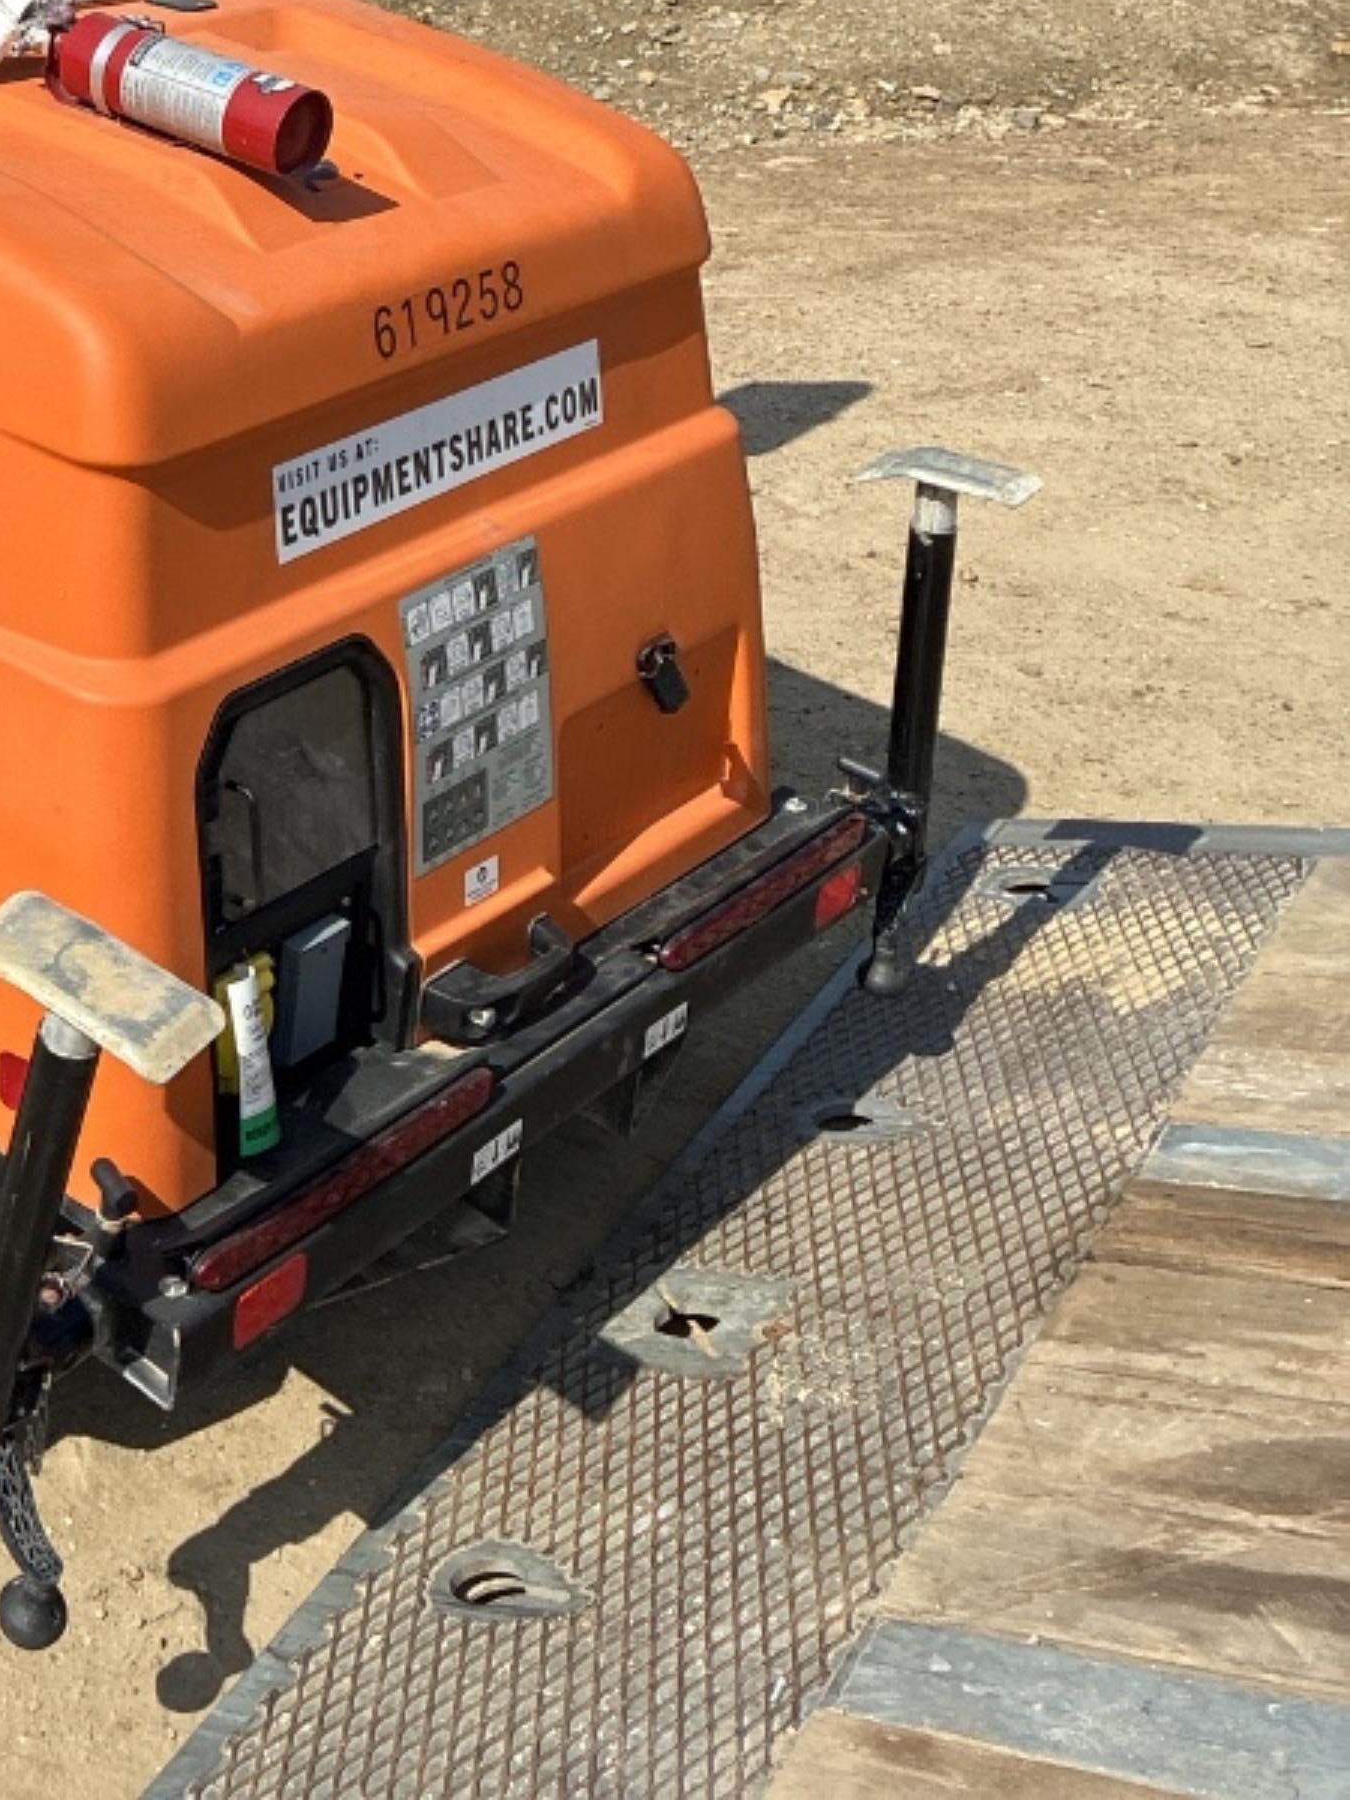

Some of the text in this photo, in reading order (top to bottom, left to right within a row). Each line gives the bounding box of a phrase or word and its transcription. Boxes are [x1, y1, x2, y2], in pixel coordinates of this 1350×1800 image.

[373, 260, 524, 359] 619258
[276, 438, 380, 493] VISIT US AT:
[280, 377, 600, 547] EQUIPMENTSHARE.COM
